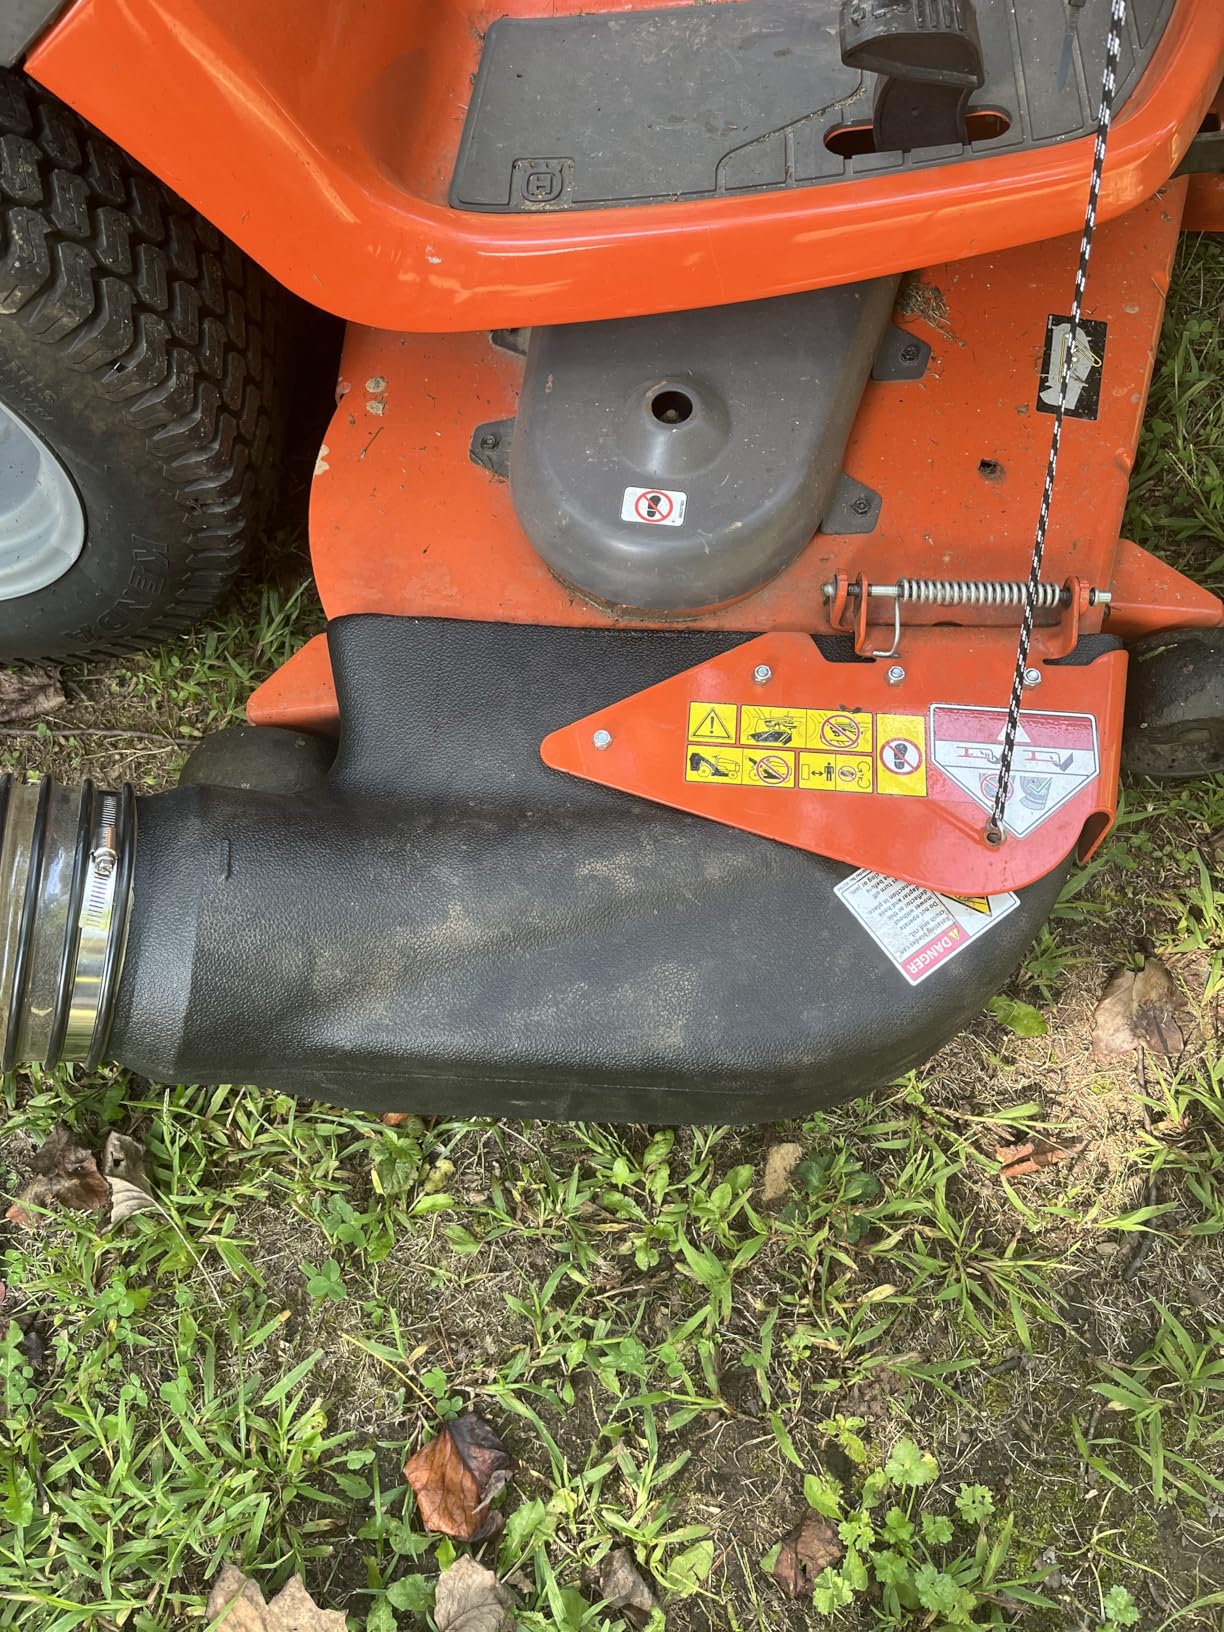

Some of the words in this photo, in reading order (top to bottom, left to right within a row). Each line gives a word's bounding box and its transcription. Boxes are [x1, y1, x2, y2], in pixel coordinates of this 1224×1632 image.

[866, 870, 880, 884] clog
[865, 878, 884, 895] before
[879, 881, 892, 893] turn
[900, 884, 921, 901] dapter
[871, 889, 882, 900] off
[882, 897, 890, 905] in
[903, 888, 928, 909] deflector
[890, 897, 903, 908] and
[914, 894, 932, 910] mower
[928, 900, 938, 910] Do
[877, 905, 892, 918] hose
[886, 910, 899, 922] this
[893, 907, 915, 926] without
[918, 906, 930, 916] not
[929, 908, 945, 922] crush
[898, 913, 920, 931] operate
[919, 920, 931, 930] and
[925, 914, 950, 935] Rotating
[909, 932, 928, 948] blades
[905, 935, 952, 974] DANGER
